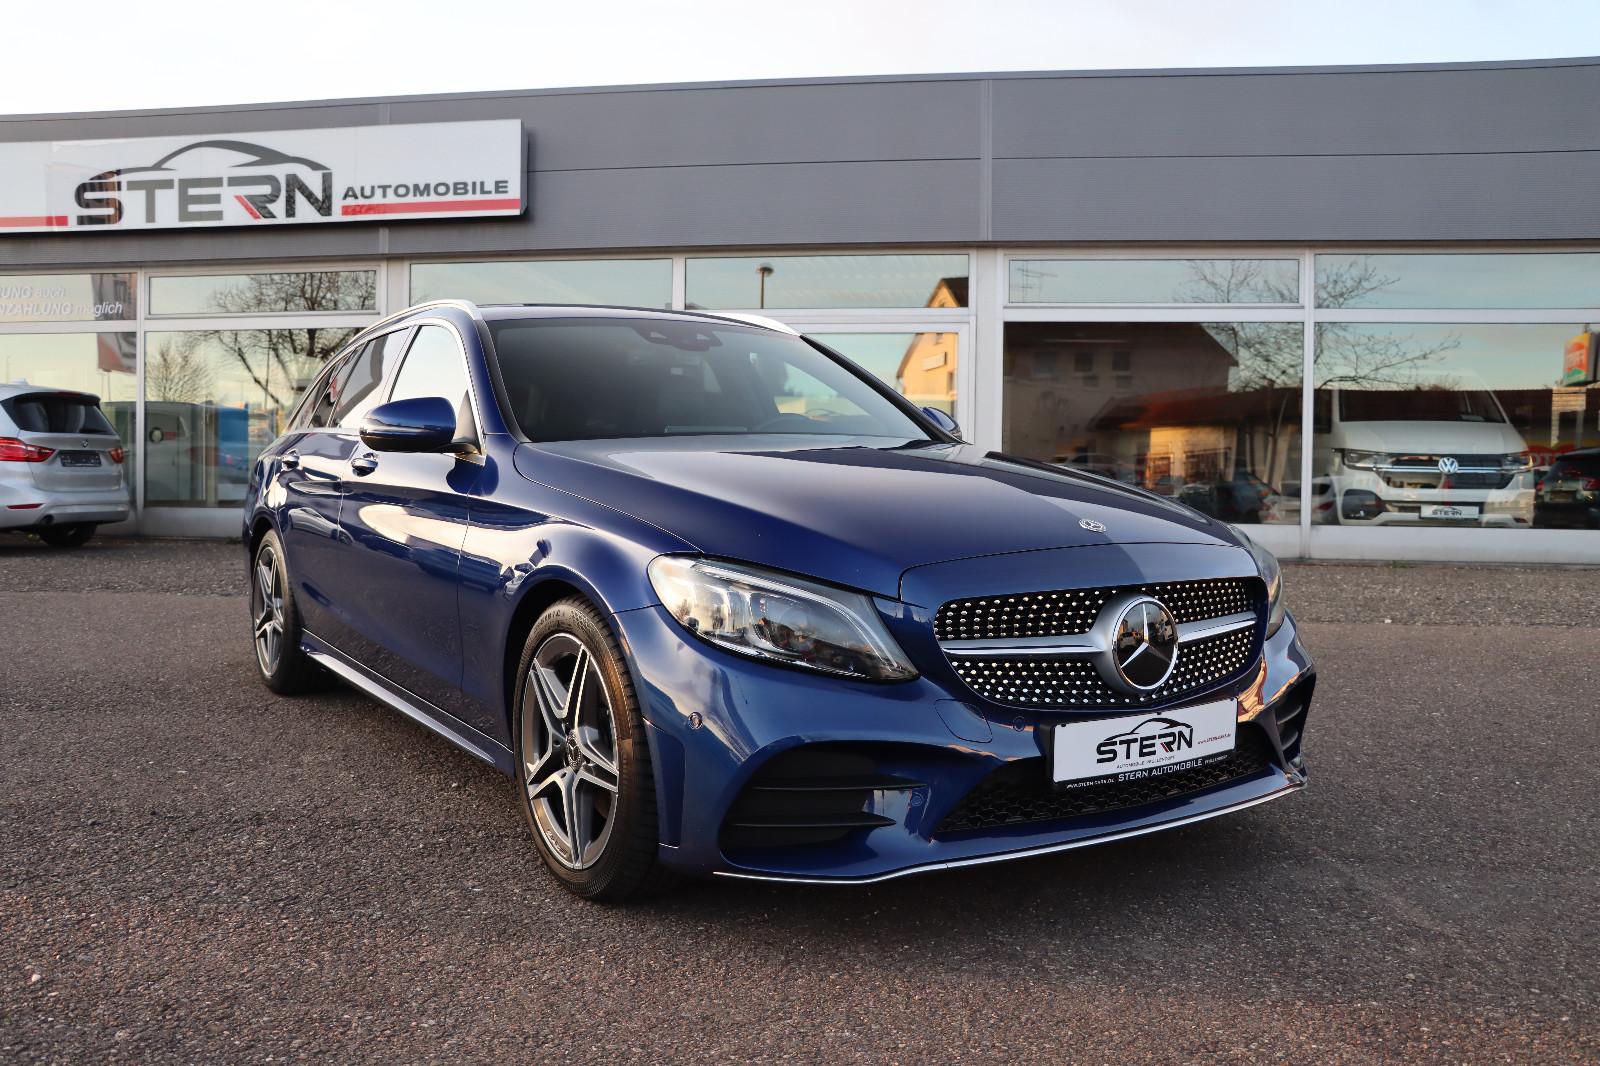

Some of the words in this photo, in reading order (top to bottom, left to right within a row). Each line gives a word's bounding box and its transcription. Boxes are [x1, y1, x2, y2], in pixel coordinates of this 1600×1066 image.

[75, 170, 333, 226] STERN
[342, 180, 509, 201] AUTOMOBILE
[1096, 727, 1194, 764] STERN
[1118, 770, 1149, 782] STERN
[1151, 759, 1203, 776] AUTOMOBILE
